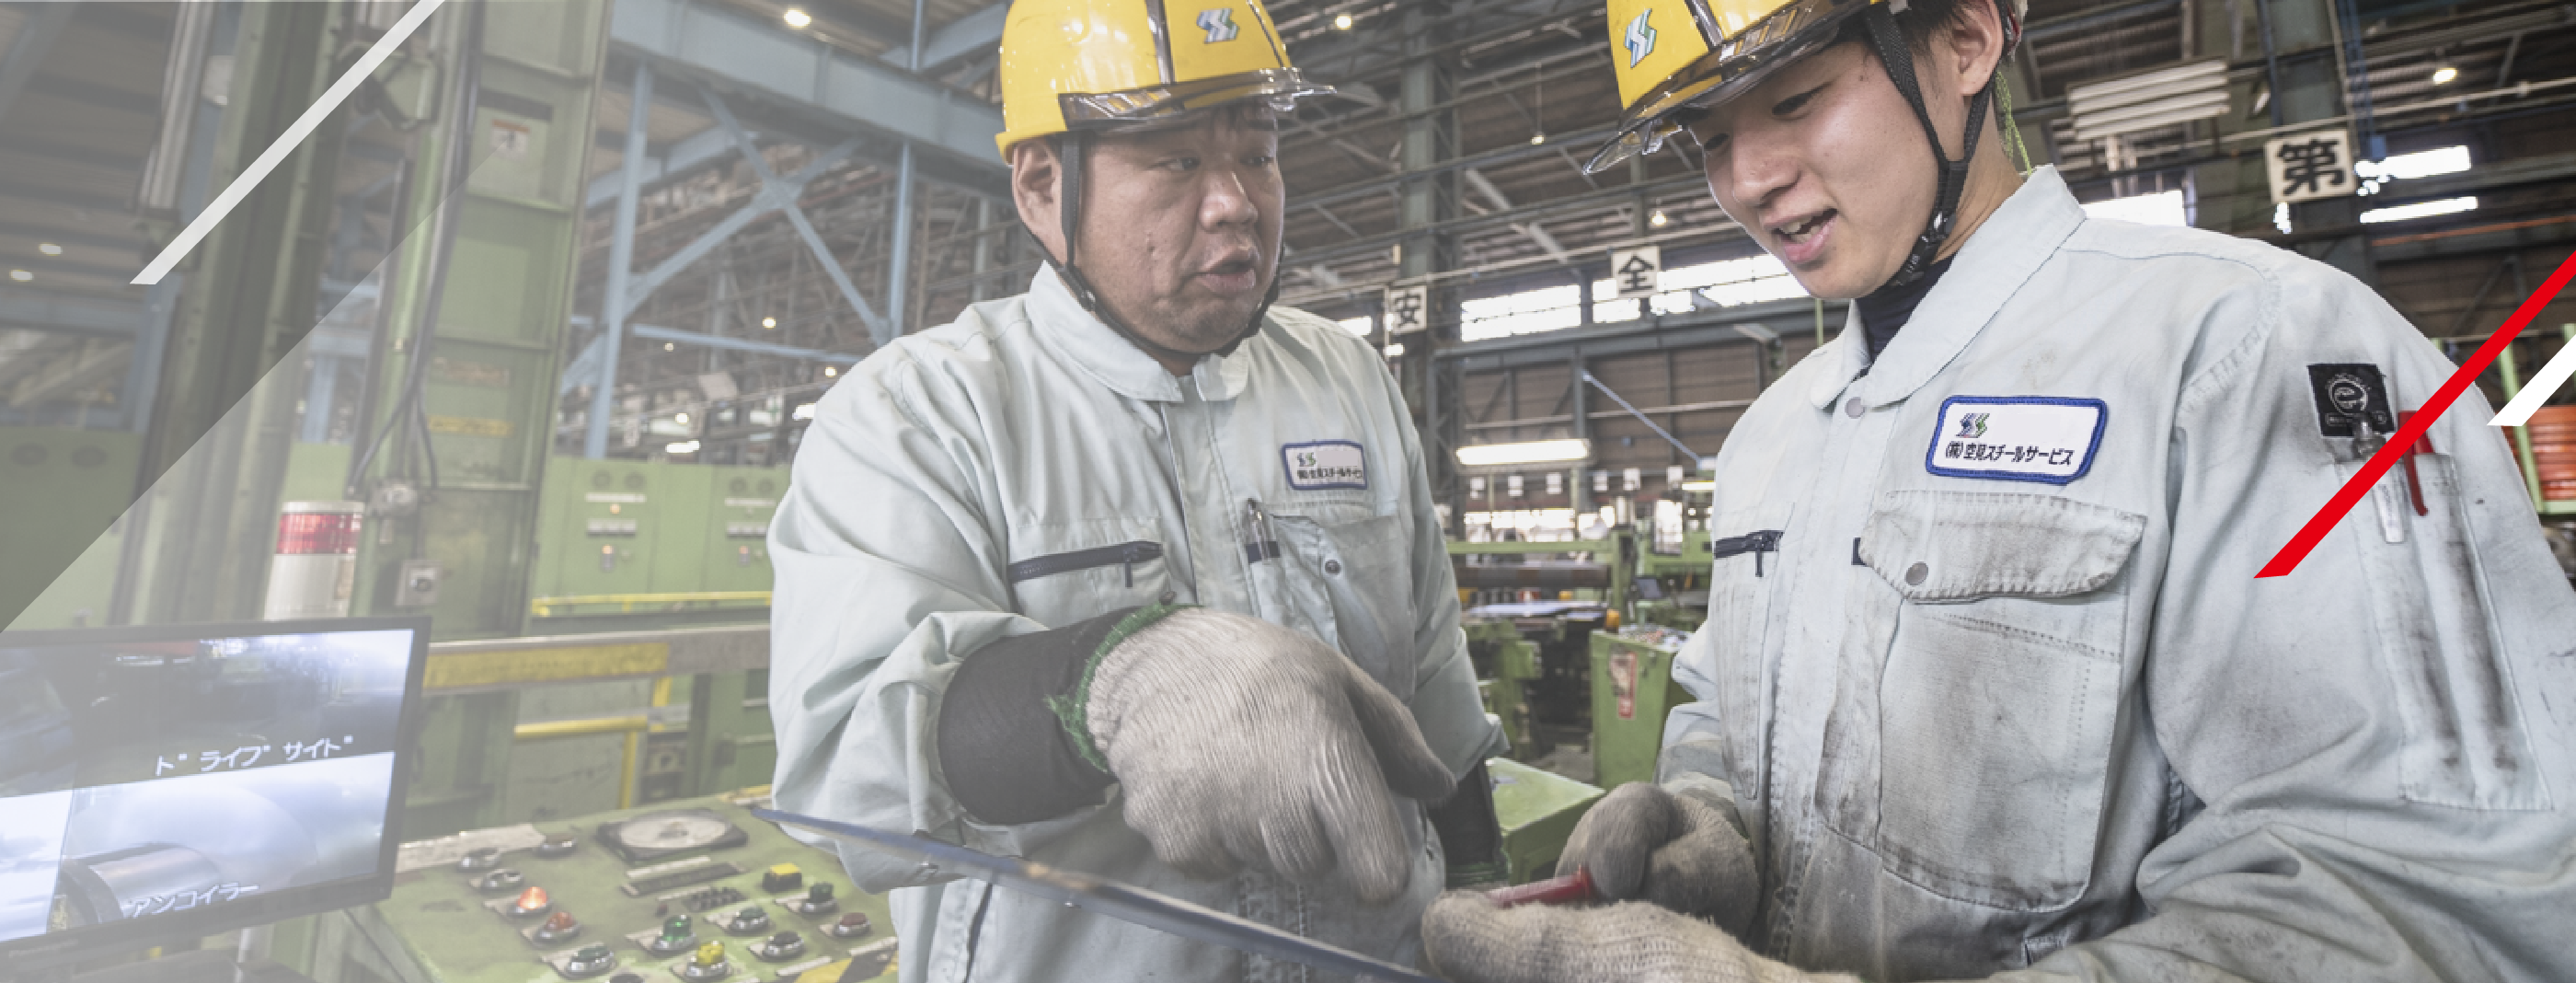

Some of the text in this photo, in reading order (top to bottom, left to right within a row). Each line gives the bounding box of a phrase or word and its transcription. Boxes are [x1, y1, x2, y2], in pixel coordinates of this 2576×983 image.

[2277, 139, 2345, 196] 第
[1618, 255, 1655, 294] 全
[1394, 293, 1421, 328] 安
[121, 882, 260, 919] アンコイラー
